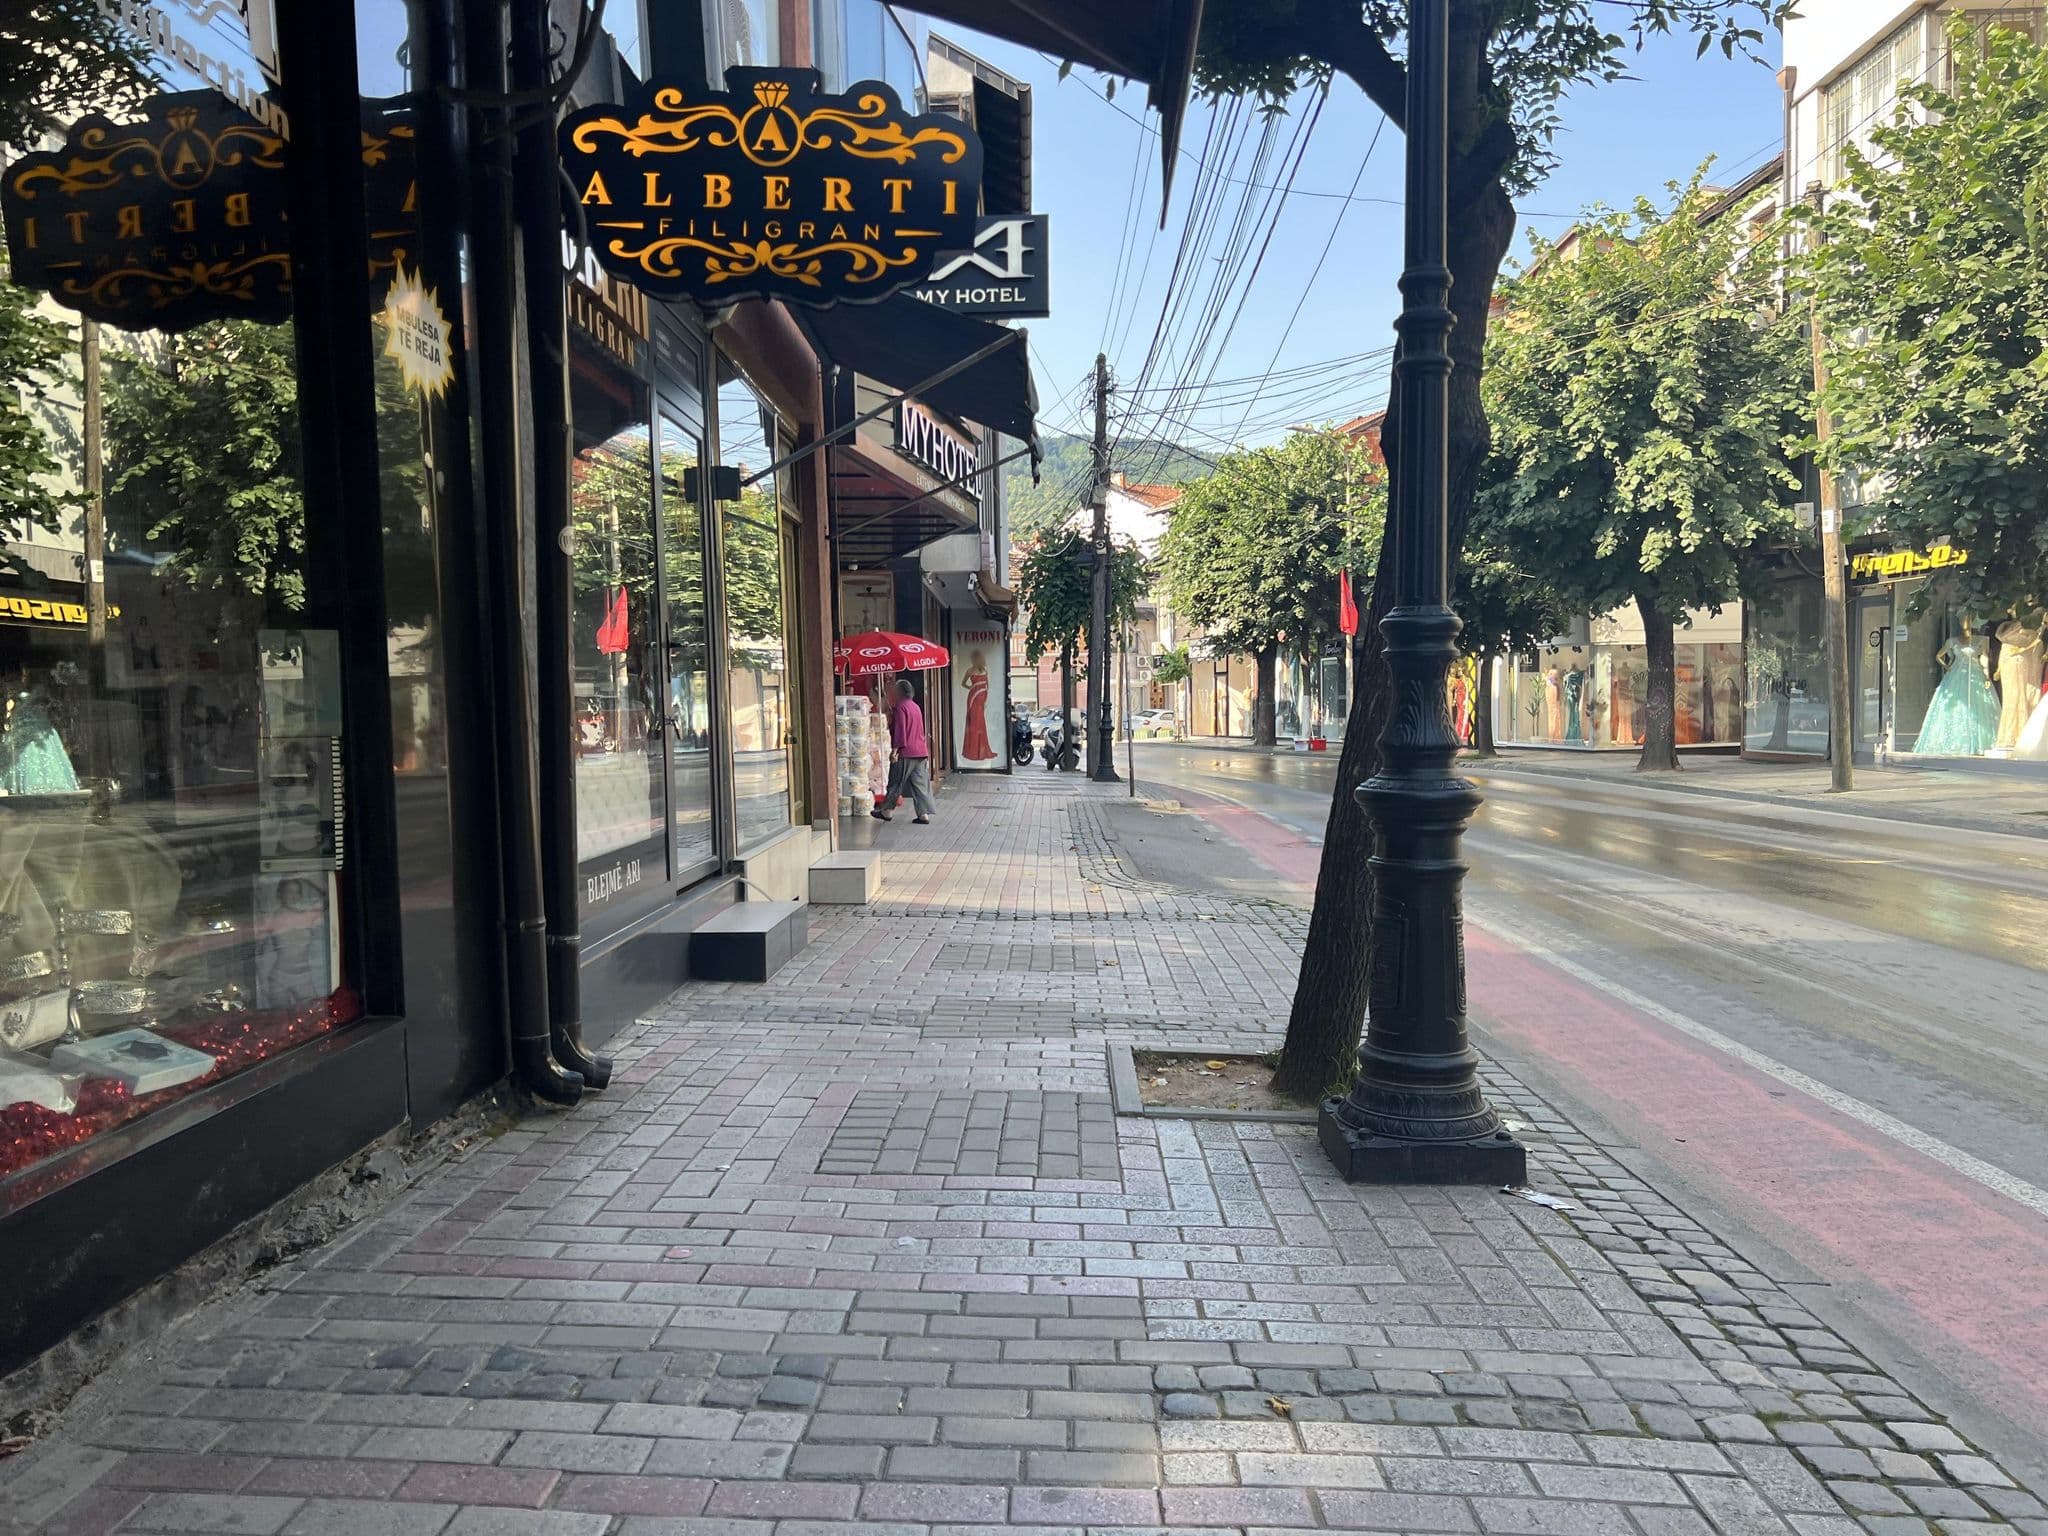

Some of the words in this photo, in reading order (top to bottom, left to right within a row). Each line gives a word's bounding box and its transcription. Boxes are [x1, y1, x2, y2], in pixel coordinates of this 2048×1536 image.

[752, 112, 790, 152] A
[580, 169, 958, 215] ALBERTI
[658, 217, 881, 241] FILIGRAN
[916, 289, 949, 304] MY
[956, 287, 1026, 304] HOTEL
[415, 335, 442, 367] REJA
[626, 858, 641, 887] ARI
